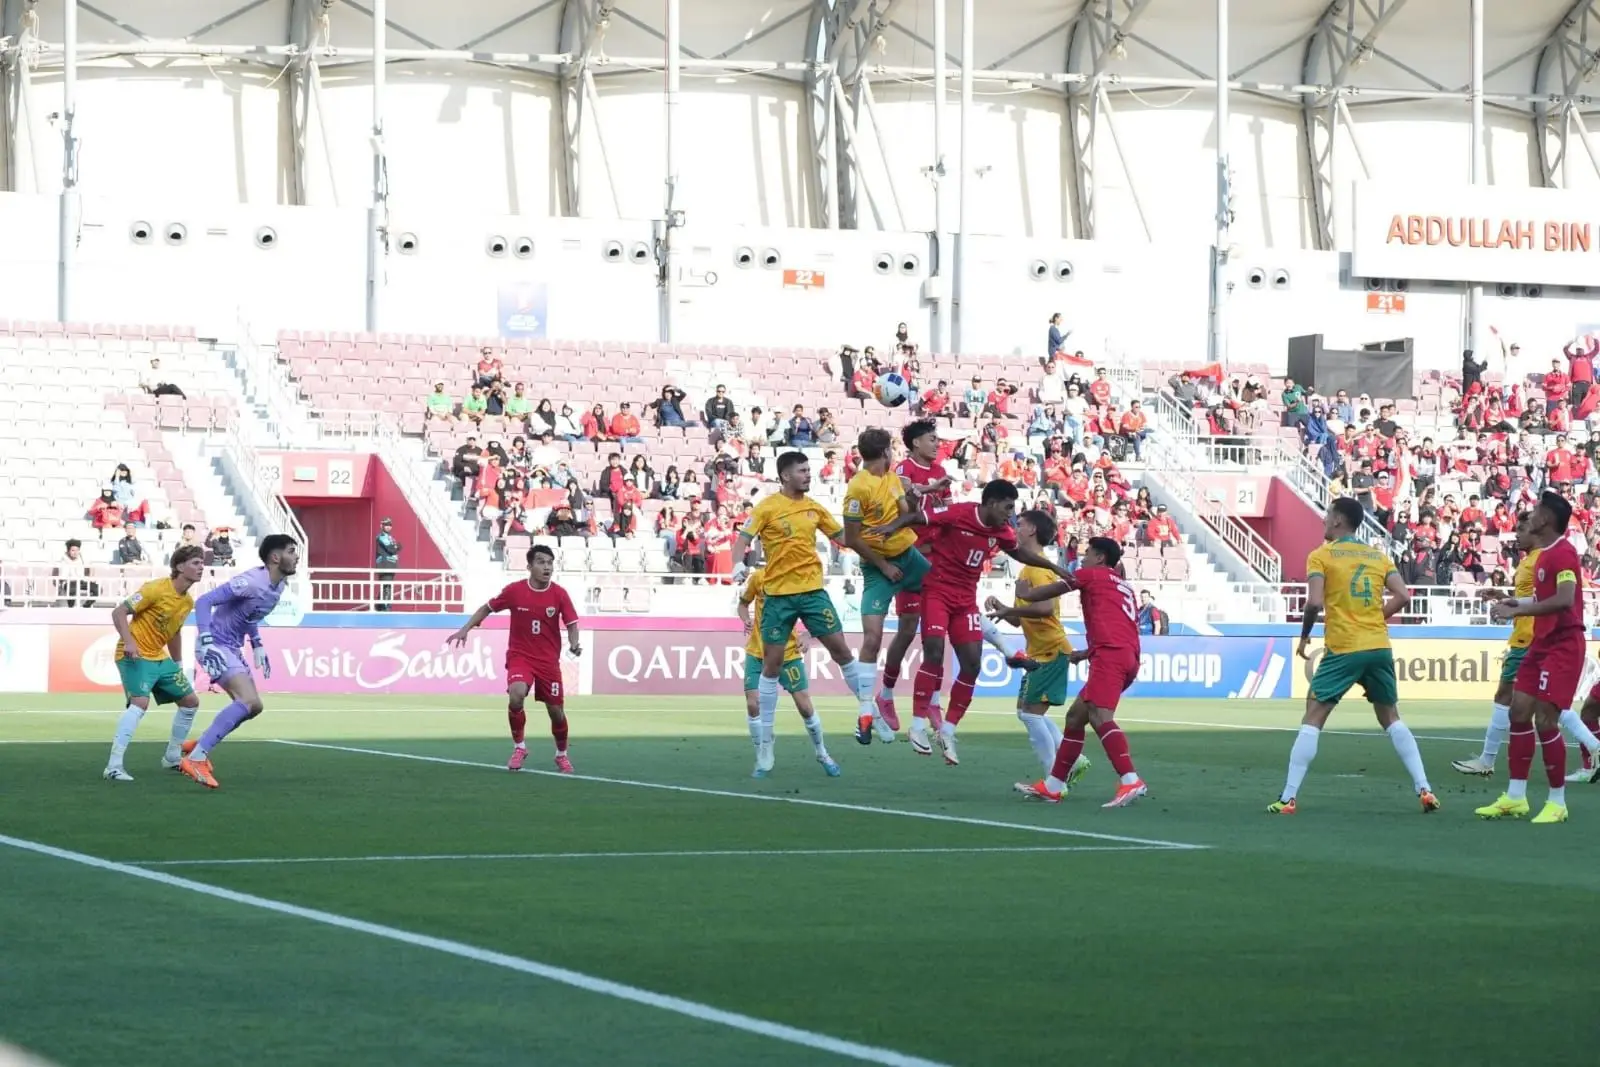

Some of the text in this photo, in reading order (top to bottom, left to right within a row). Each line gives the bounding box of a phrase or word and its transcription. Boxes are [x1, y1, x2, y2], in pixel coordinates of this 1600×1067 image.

[1386, 215, 1535, 250] ABDULLAH
[1544, 221, 1591, 252] BIN
[330, 470, 351, 484] 22
[1238, 490, 1254, 504] 21
[966, 549, 984, 567] 19
[1350, 563, 1373, 607] 4
[531, 620, 541, 634] 8
[822, 608, 837, 629] 3
[967, 613, 982, 631] 19
[281, 647, 357, 678] Visit
[608, 645, 746, 682] QATAR
[784, 666, 801, 682] 10
[1538, 671, 1549, 690] 5
